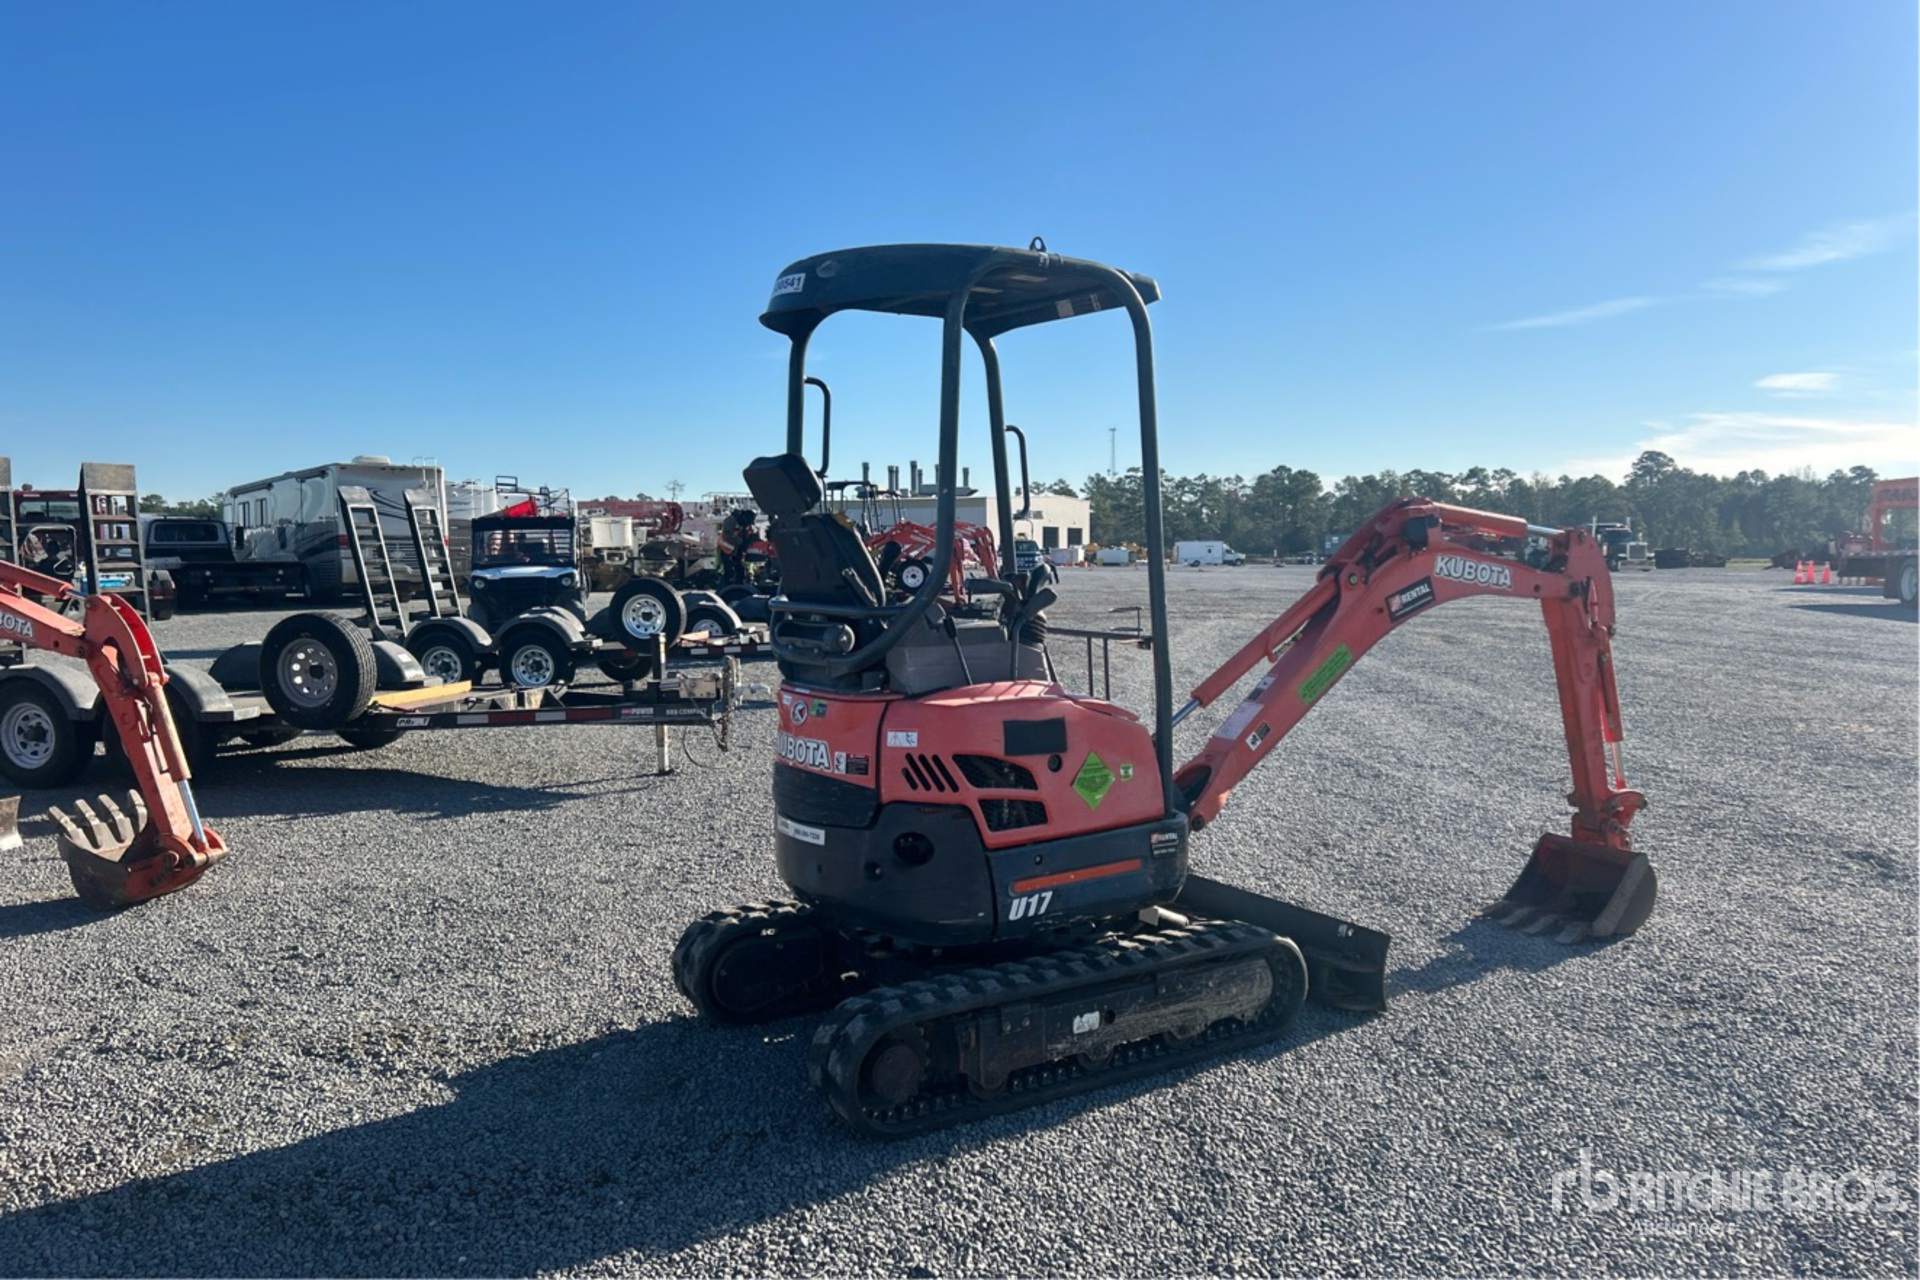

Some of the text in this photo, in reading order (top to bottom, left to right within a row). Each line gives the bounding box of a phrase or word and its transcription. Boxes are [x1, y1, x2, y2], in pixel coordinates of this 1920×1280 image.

[1435, 554, 1512, 588] KUBOTA
[1401, 583, 1431, 604] RENTAL
[777, 734, 831, 770] UBOTA
[1008, 891, 1053, 921] U17
